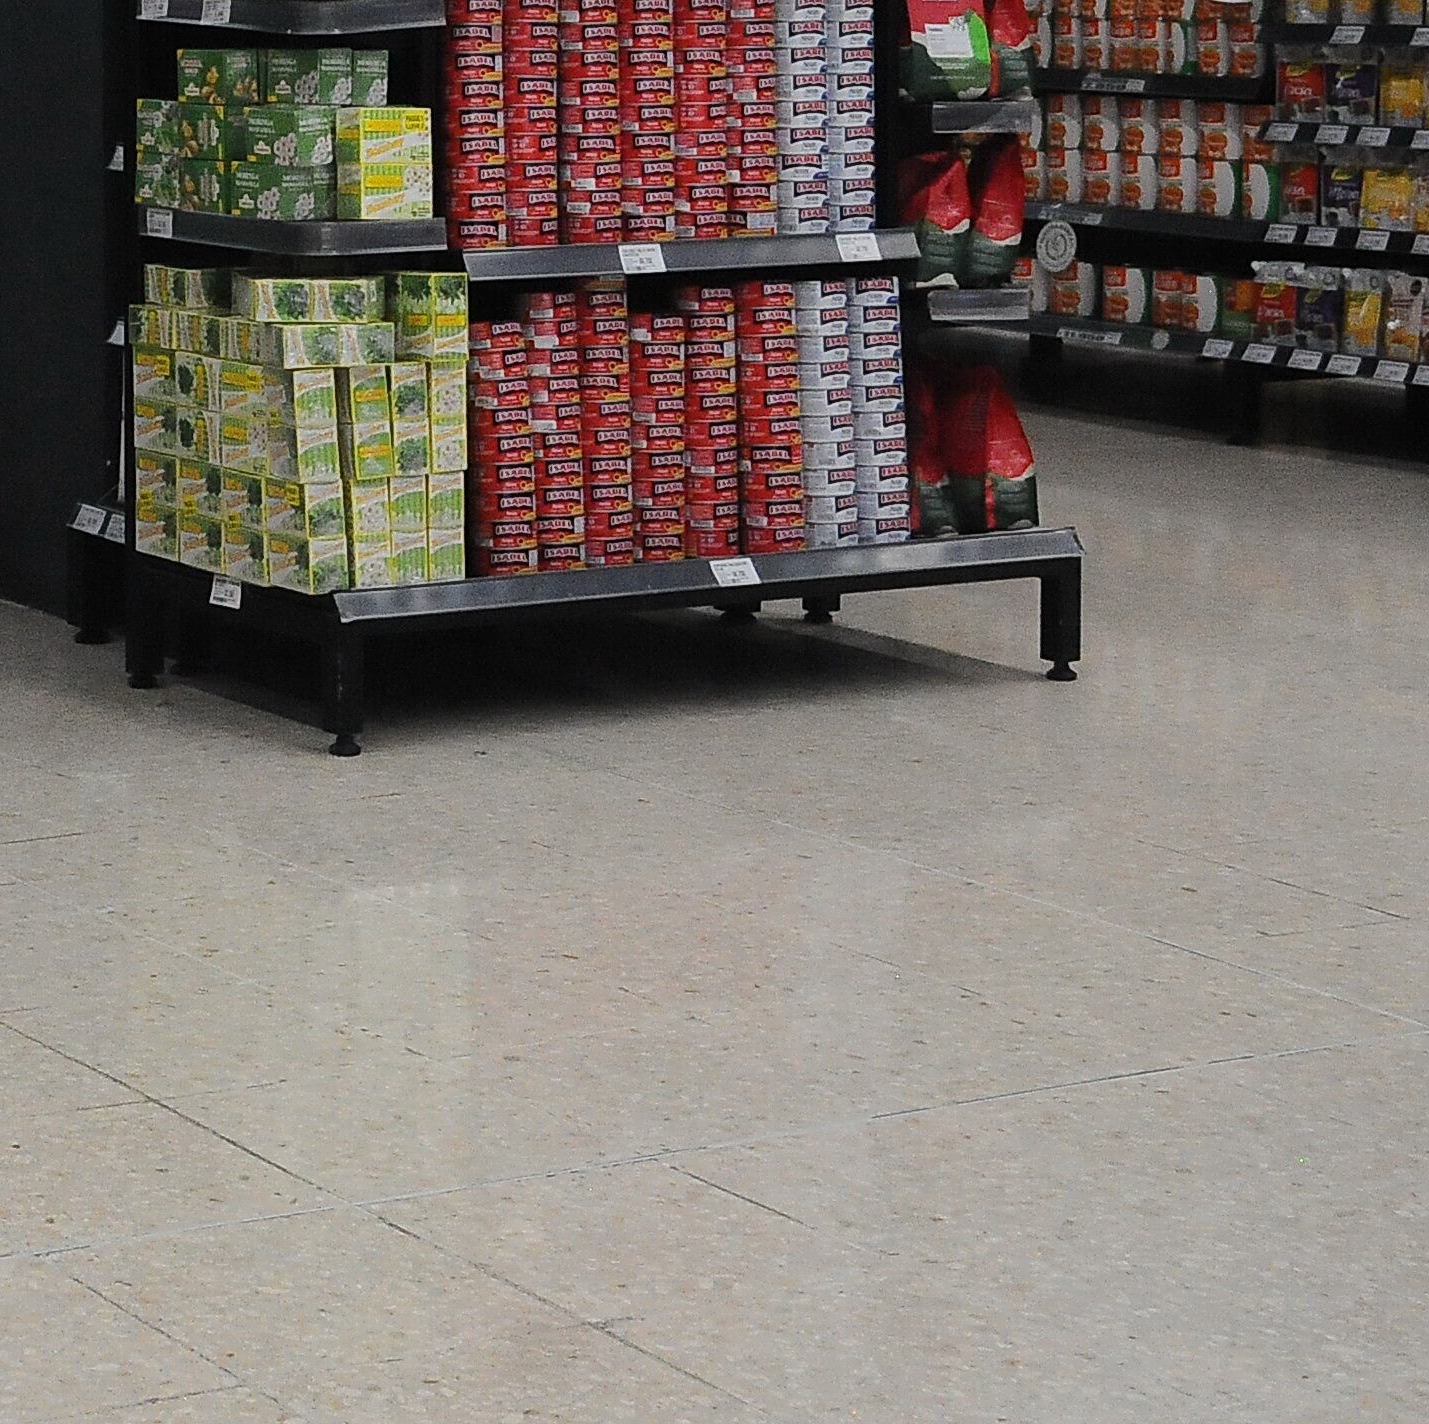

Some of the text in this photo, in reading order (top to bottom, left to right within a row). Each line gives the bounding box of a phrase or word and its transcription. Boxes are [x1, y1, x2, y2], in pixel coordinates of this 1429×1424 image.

[453, 27, 491, 38] ISABEL
[457, 55, 494, 67] ISABEL
[579, 138, 615, 150] ISABEL
[785, 155, 822, 166] ISABEL
[733, 186, 769, 197] ISABEL
[628, 218, 664, 229] ISABEL
[460, 225, 498, 237] ISABEL
[858, 280, 893, 290] ISABEL
[580, 377, 619, 388] ISABEL
[869, 387, 902, 397] ISABEL
[753, 450, 790, 461] ISABEL
[491, 552, 528, 563] ISABEL
